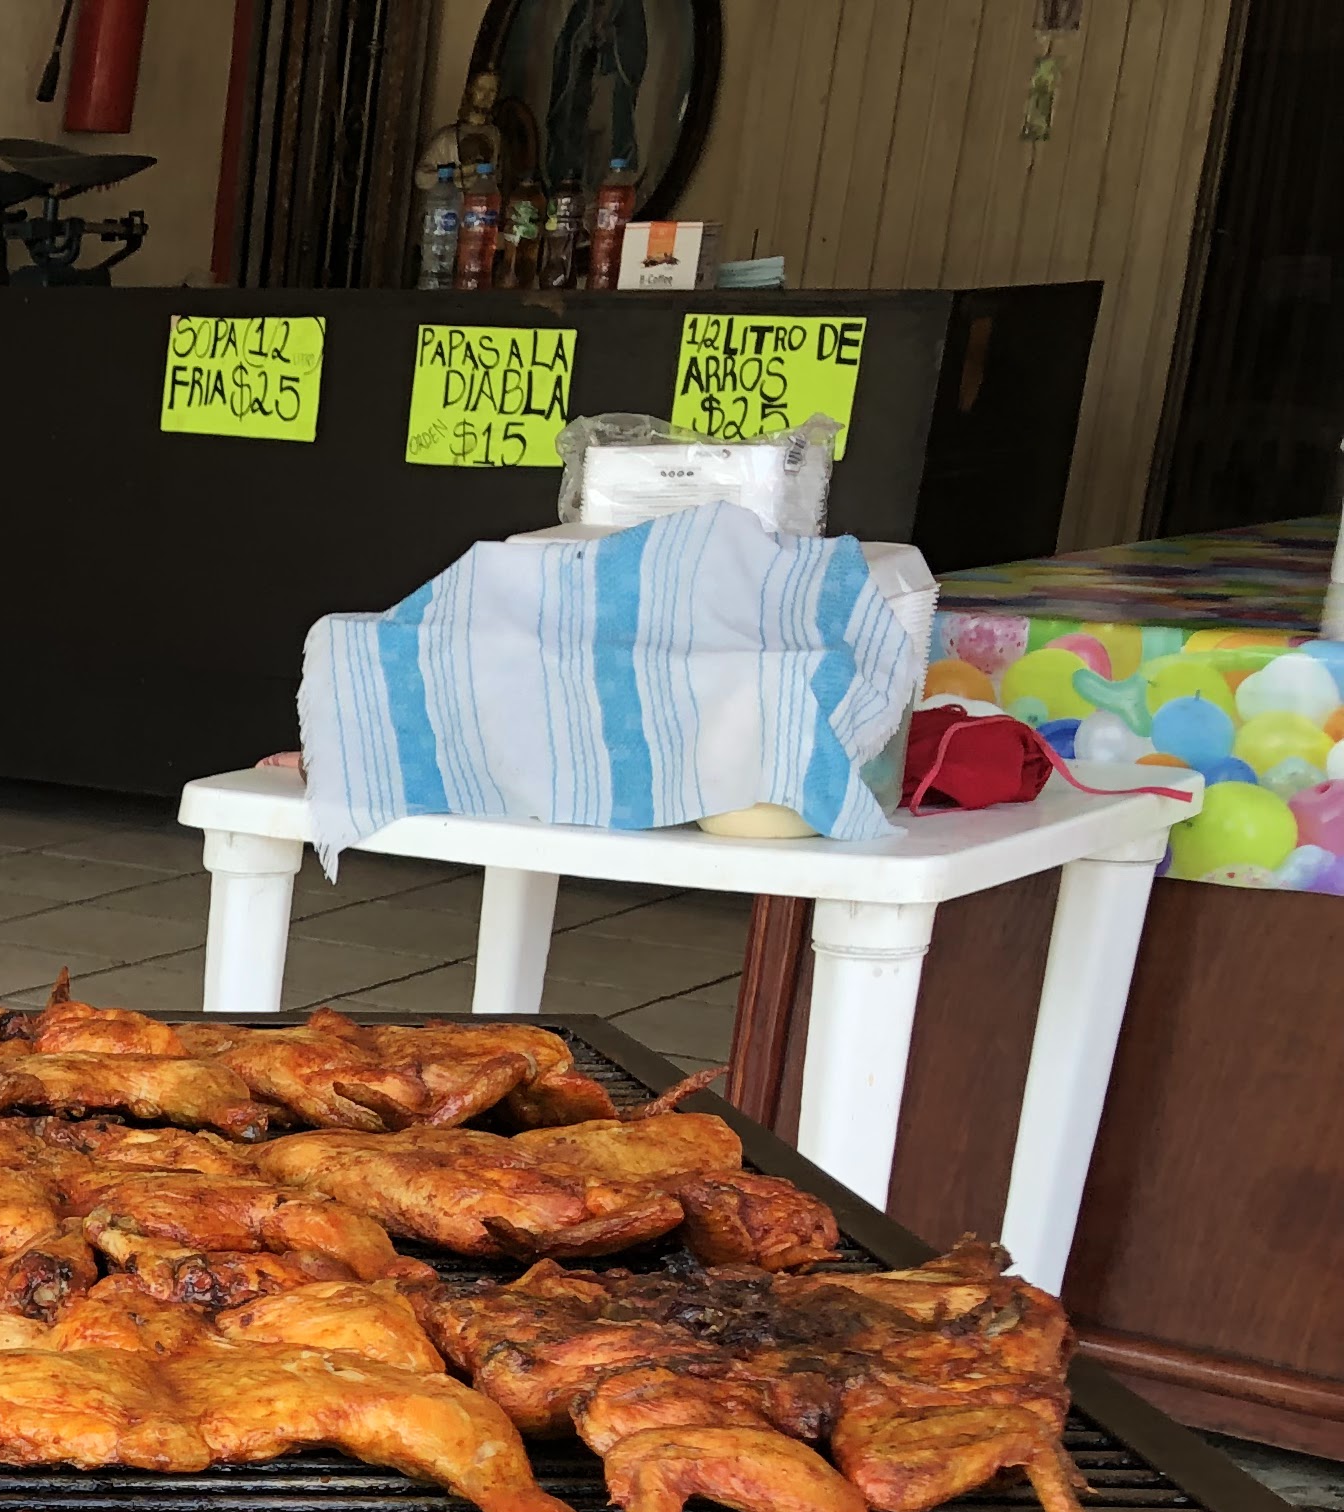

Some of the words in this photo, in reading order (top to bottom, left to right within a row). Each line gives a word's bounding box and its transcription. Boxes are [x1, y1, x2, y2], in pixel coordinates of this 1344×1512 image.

[172, 316, 238, 359] SOPA
[419, 327, 500, 371] PAPAS
[507, 337, 524, 369] A
[531, 329, 568, 373] LA
[685, 316, 721, 353] 1/2
[723, 316, 808, 356] LITRO
[817, 323, 863, 366] DE
[167, 365, 227, 410] FRIA
[230, 361, 301, 423] $25
[443, 369, 569, 421] DIABLA
[680, 355, 788, 403] ARROS
[408, 418, 448, 456] ORDEN
[449, 418, 527, 467] $15
